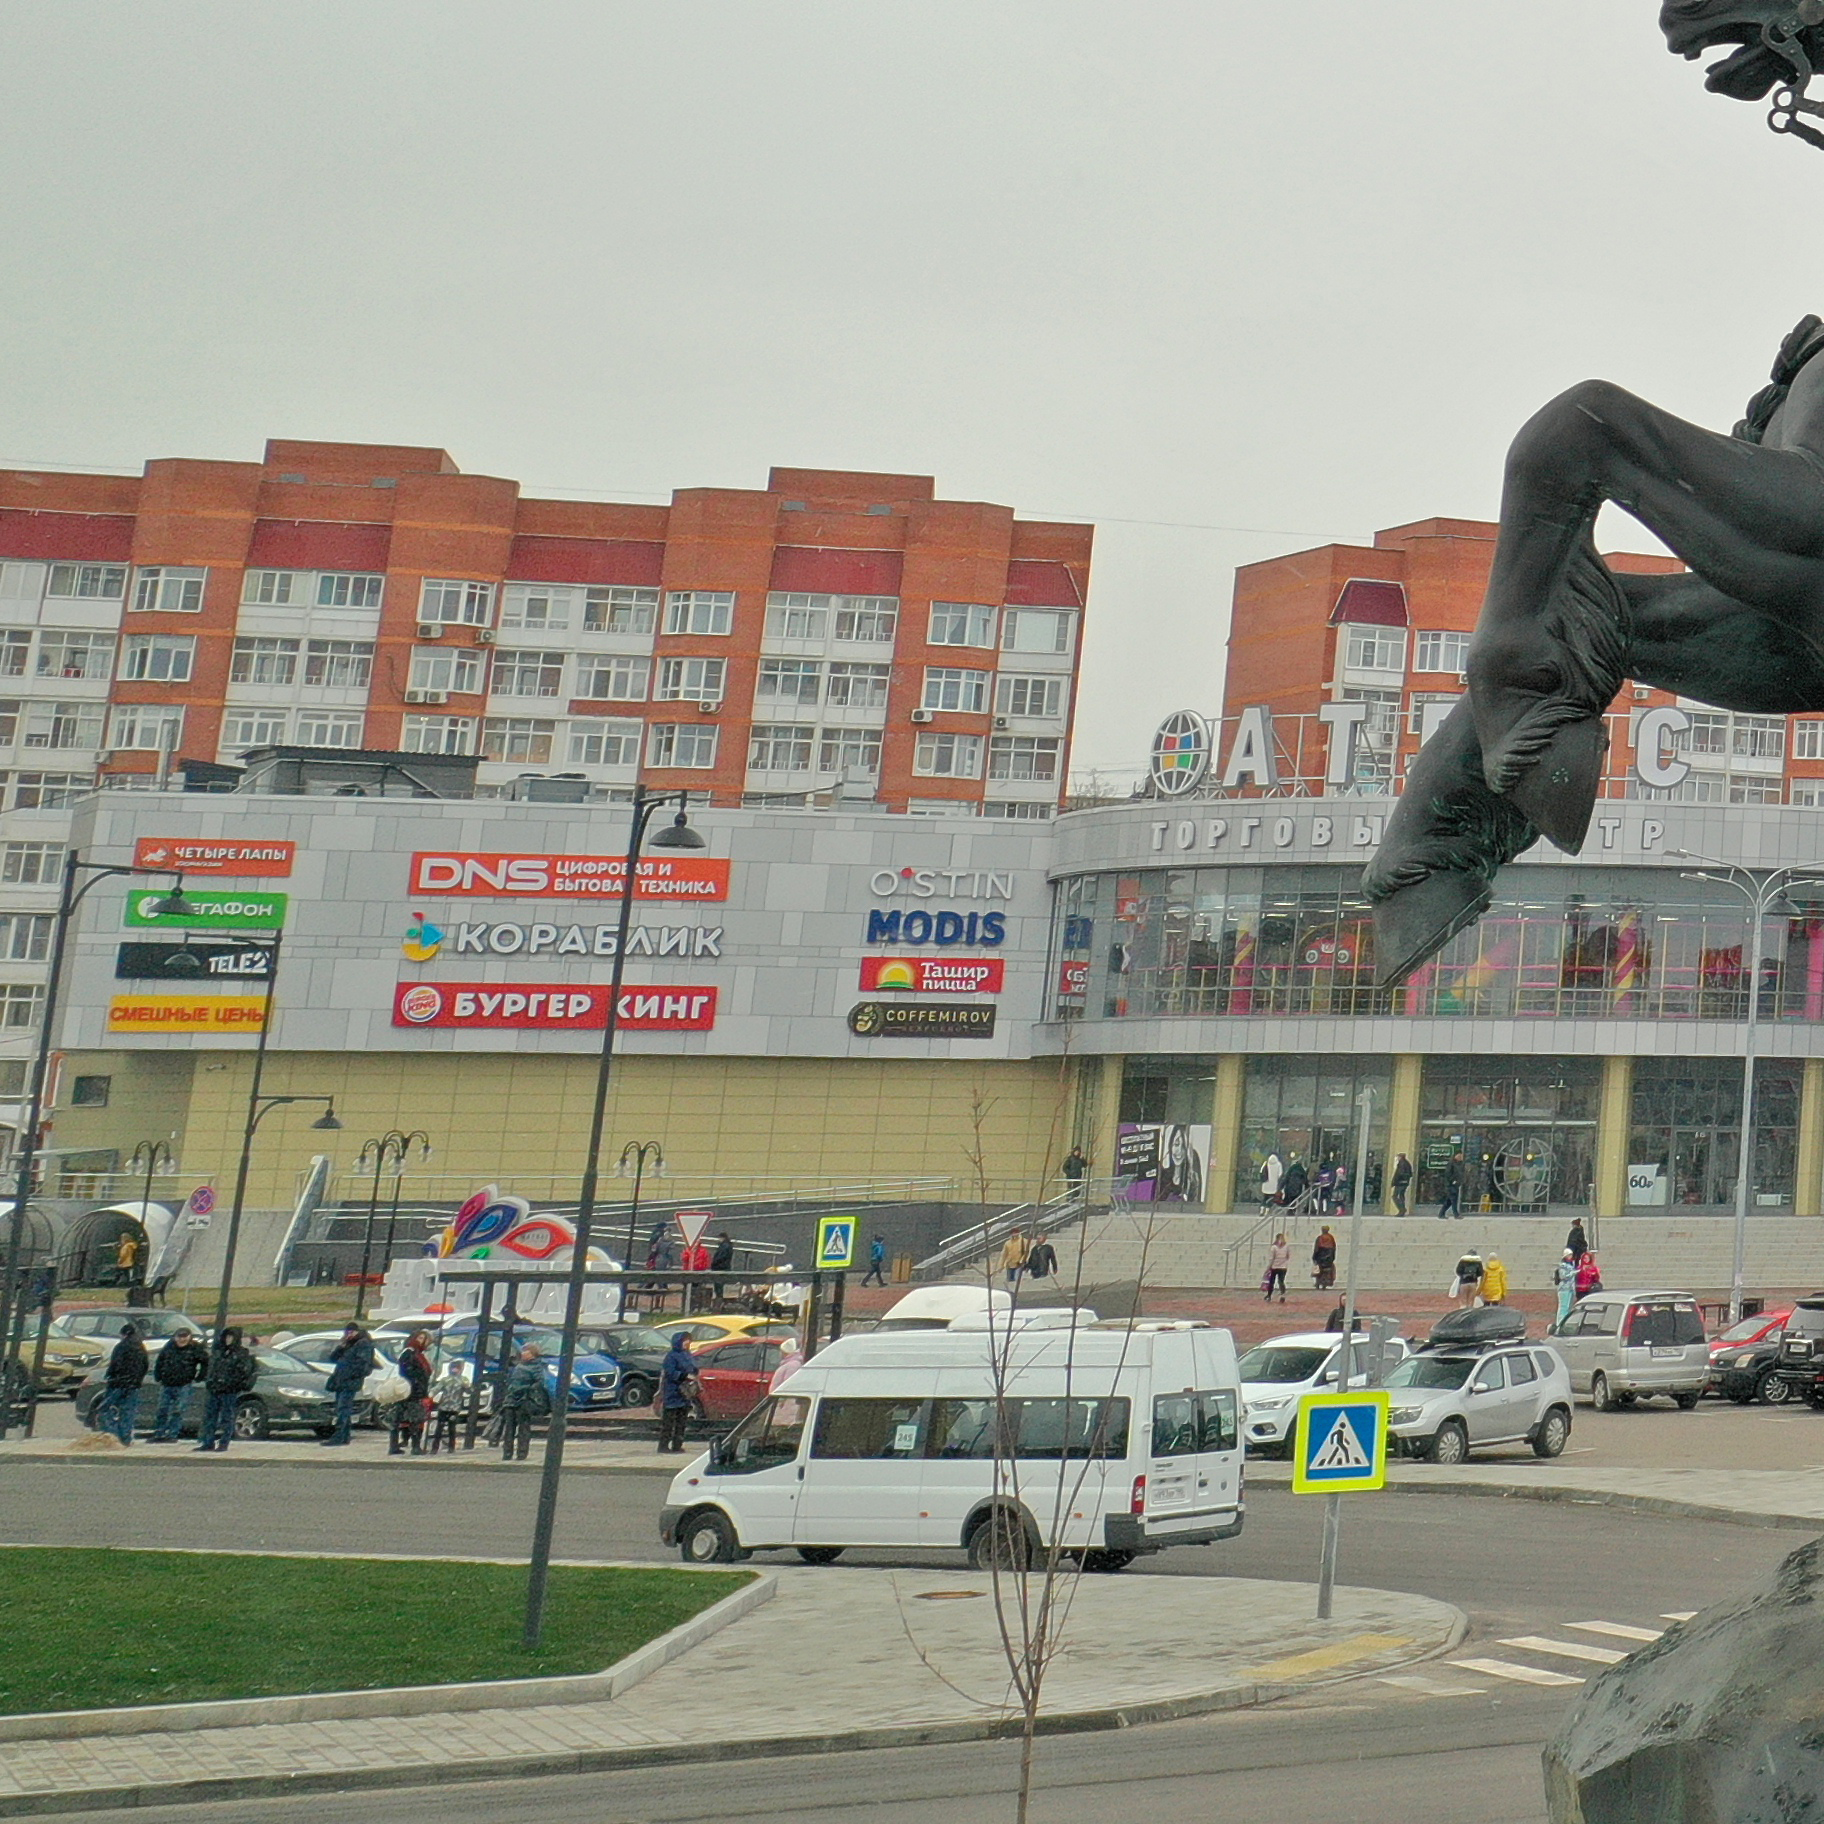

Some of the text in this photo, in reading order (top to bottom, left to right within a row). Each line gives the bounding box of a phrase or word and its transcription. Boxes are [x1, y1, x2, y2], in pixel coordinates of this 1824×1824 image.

[175, 847, 287, 861] ЧЕТЫРЕ ЛАПЫ
[419, 858, 549, 890] DNS
[657, 863, 672, 876] И
[554, 879, 716, 894] БЫТОВА ТЕХНИКА
[191, 902, 273, 916] ЕГАФОН
[867, 909, 1006, 946] MODIS
[456, 923, 724, 957] КОРАБЛИК
[208, 951, 270, 974] TELE2
[921, 962, 989, 982] Ташир
[922, 979, 977, 991] пицца
[454, 992, 592, 1018] БУРГЕР
[110, 1007, 209, 1022] СМЕШНЫЕ
[886, 1010, 990, 1022] COFFEMIROV
